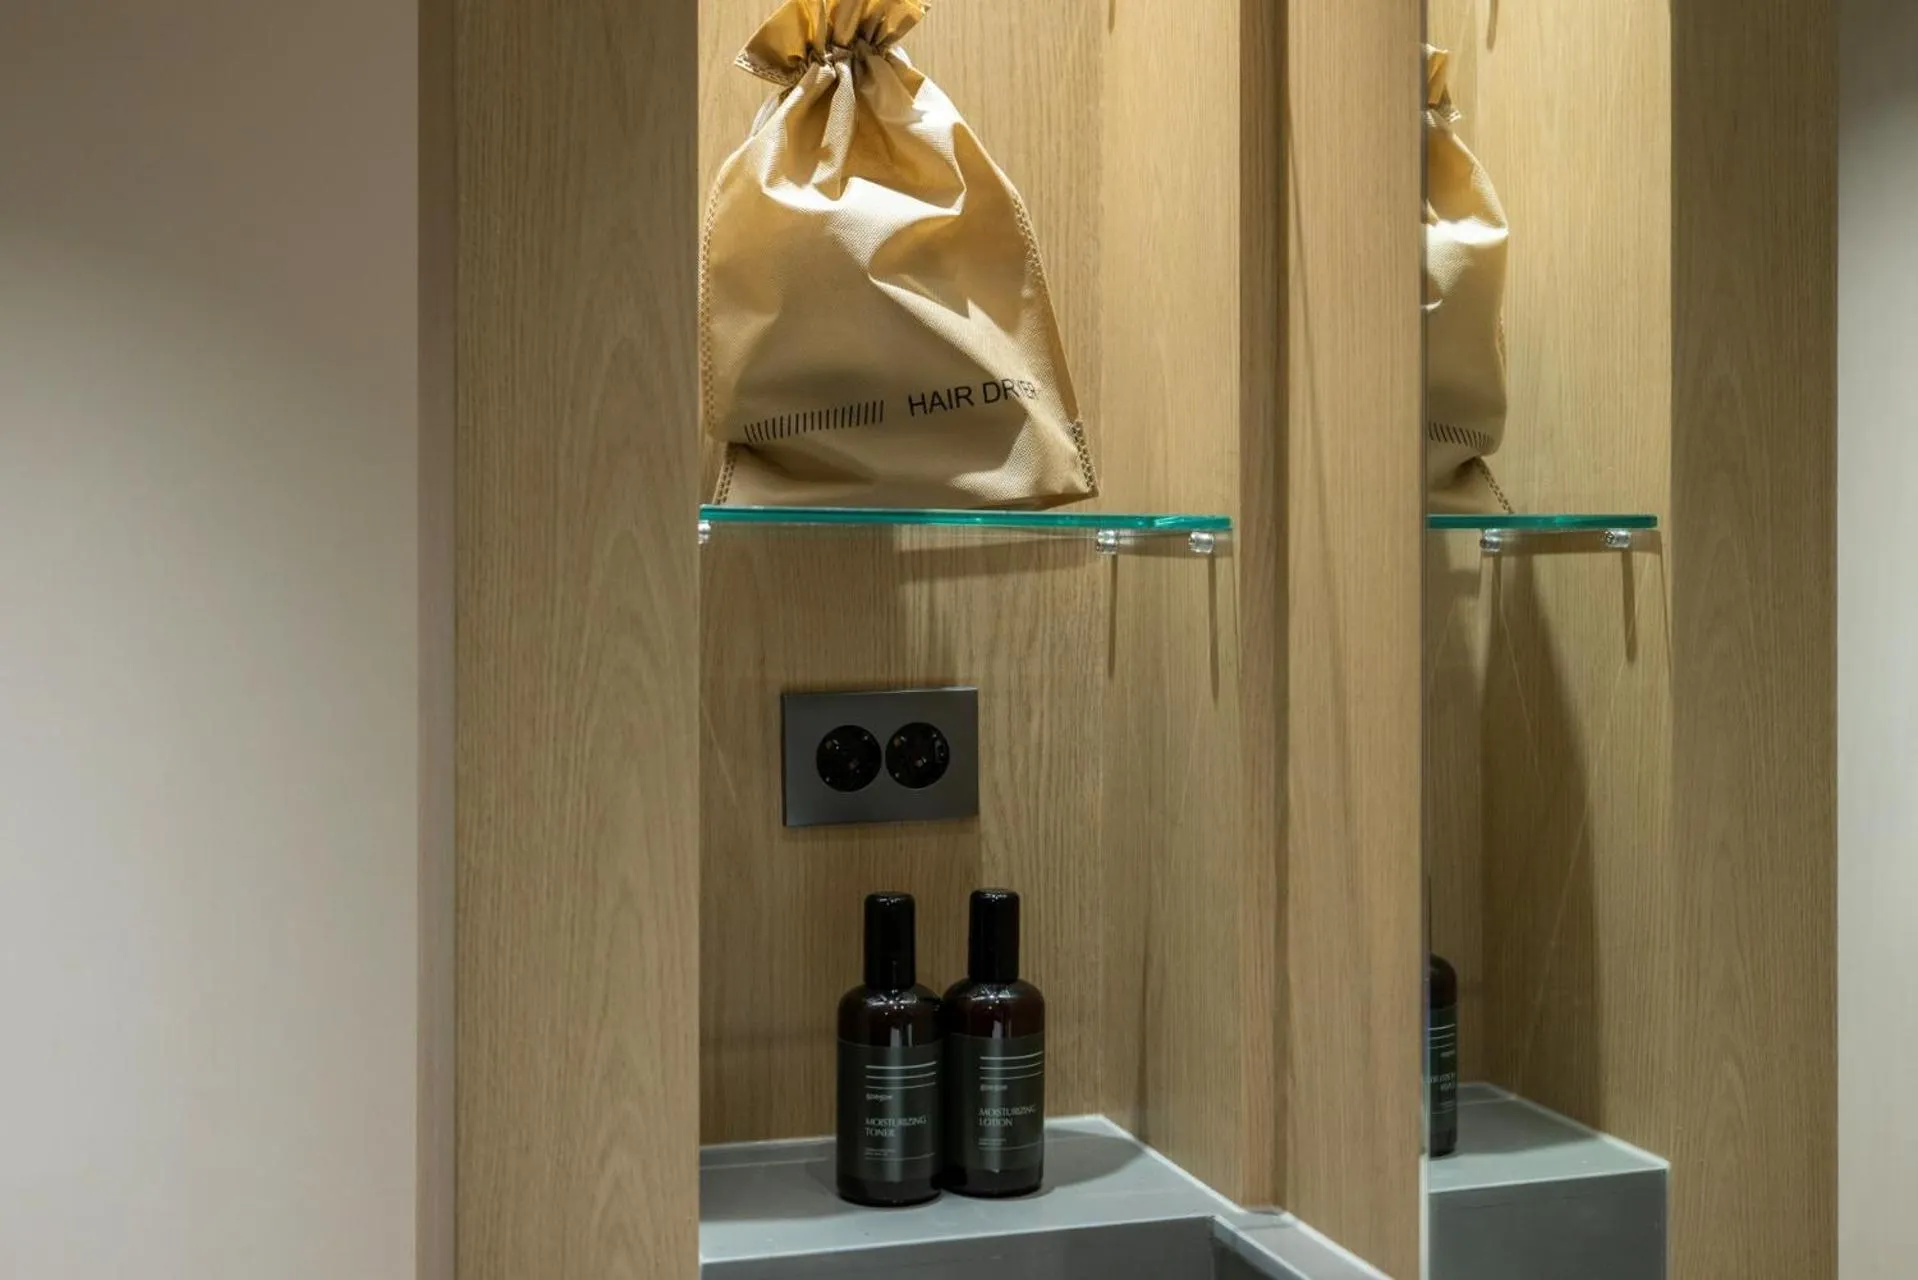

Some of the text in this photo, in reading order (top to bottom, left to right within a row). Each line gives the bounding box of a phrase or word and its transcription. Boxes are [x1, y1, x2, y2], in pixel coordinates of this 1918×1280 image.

[908, 378, 1037, 416] HAIR DRER
[979, 1117, 1013, 1127] LOTION
